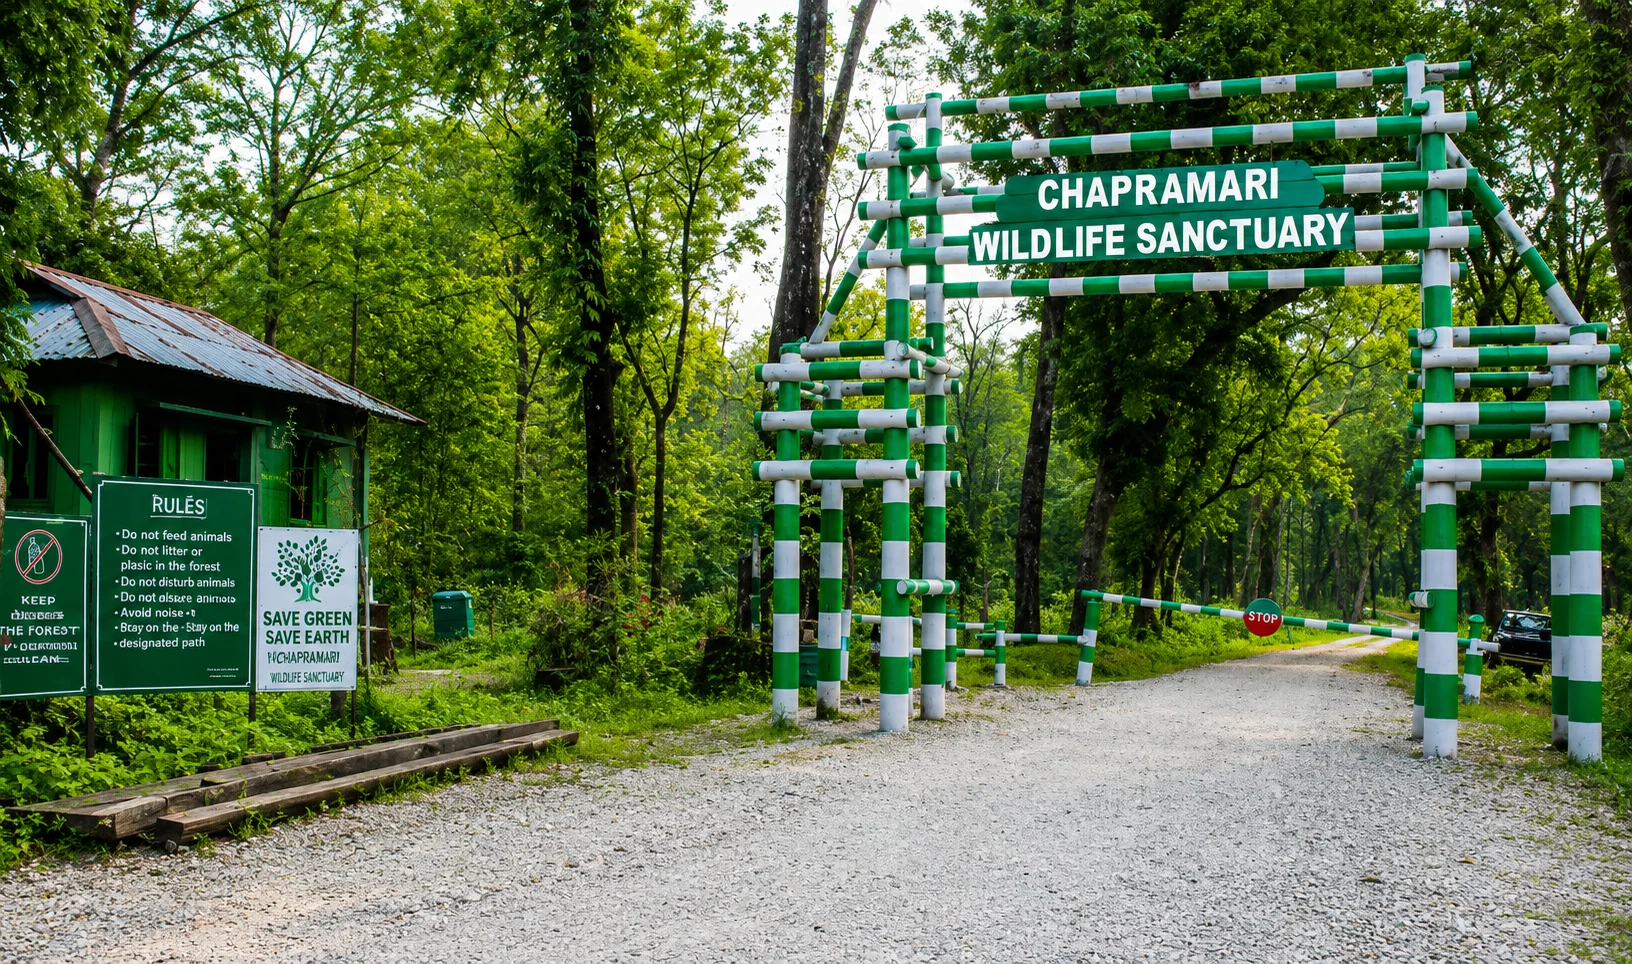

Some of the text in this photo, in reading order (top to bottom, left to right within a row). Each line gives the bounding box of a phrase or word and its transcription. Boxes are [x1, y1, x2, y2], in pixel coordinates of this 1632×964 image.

[1037, 167, 1280, 211] CHAPRAMARI
[972, 212, 1349, 262] WILDLIFE SANCTUARY
[152, 495, 205, 515] RULES
[122, 529, 233, 542] Do not feed animals
[121, 545, 203, 556] Do not litter or
[155, 561, 165, 571] in
[168, 560, 186, 571] the
[189, 560, 221, 572] forest
[121, 576, 236, 588] Do not disturb animals
[21, 595, 56, 605] KEEP
[120, 591, 136, 602] Do
[139, 592, 156, 602] not
[120, 607, 152, 618] Avoid
[155, 607, 184, 618] noise
[263, 610, 352, 626] SAVE GREEN
[1248, 611, 1279, 624] STOP
[0, 625, 24, 636] THE
[145, 624, 159, 633] on
[162, 621, 179, 633] the
[209, 624, 222, 632] on
[224, 621, 240, 633] the
[265, 629, 350, 645] SAVE EARTH
[119, 637, 205, 650] designated path
[270, 671, 345, 683] WILDLIFE SANCTUARY
